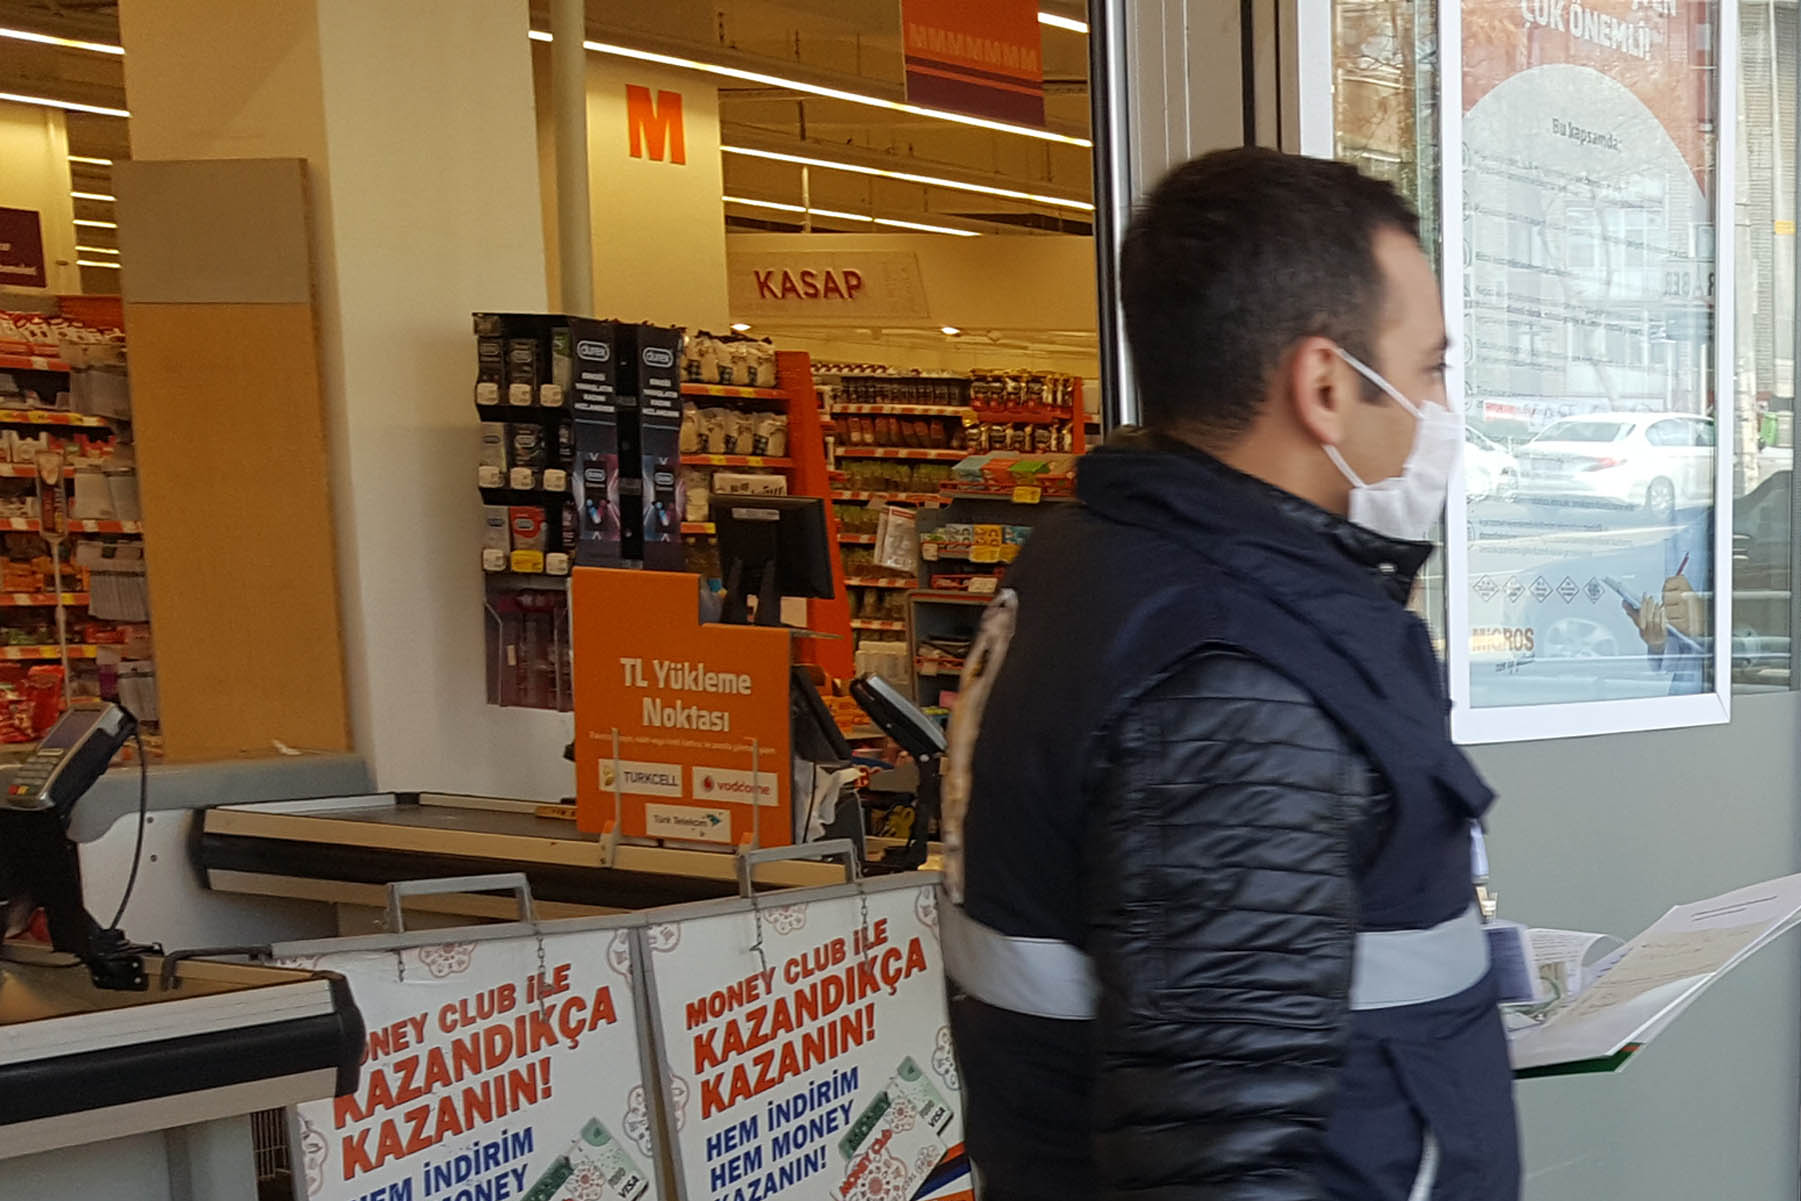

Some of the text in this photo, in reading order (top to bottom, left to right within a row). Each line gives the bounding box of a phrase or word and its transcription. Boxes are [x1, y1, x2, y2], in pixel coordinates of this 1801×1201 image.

[625, 83, 686, 165] M
[1552, 117, 1567, 137] Bu
[753, 268, 864, 301] KASAP
[620, 657, 752, 696] TL Yükleme
[642, 697, 730, 733] Noktası
[623, 770, 680, 788] TURKCELL
[361, 1012, 429, 1066] NEY
[438, 982, 517, 1034] CLUB
[685, 966, 777, 1031] MONEY
[783, 937, 847, 985] CLUB
[692, 936, 928, 1075] KAZANDIKÇA
[333, 985, 618, 1130] KAZANDIKÇA
[699, 1002, 876, 1120] KAZANIN!
[341, 1056, 553, 1181] KAZANIN!
[706, 1066, 859, 1162] HEM İNDİRİM
[710, 1098, 854, 1193] HEM MONEY
[423, 1126, 534, 1197] İNDİRİM
